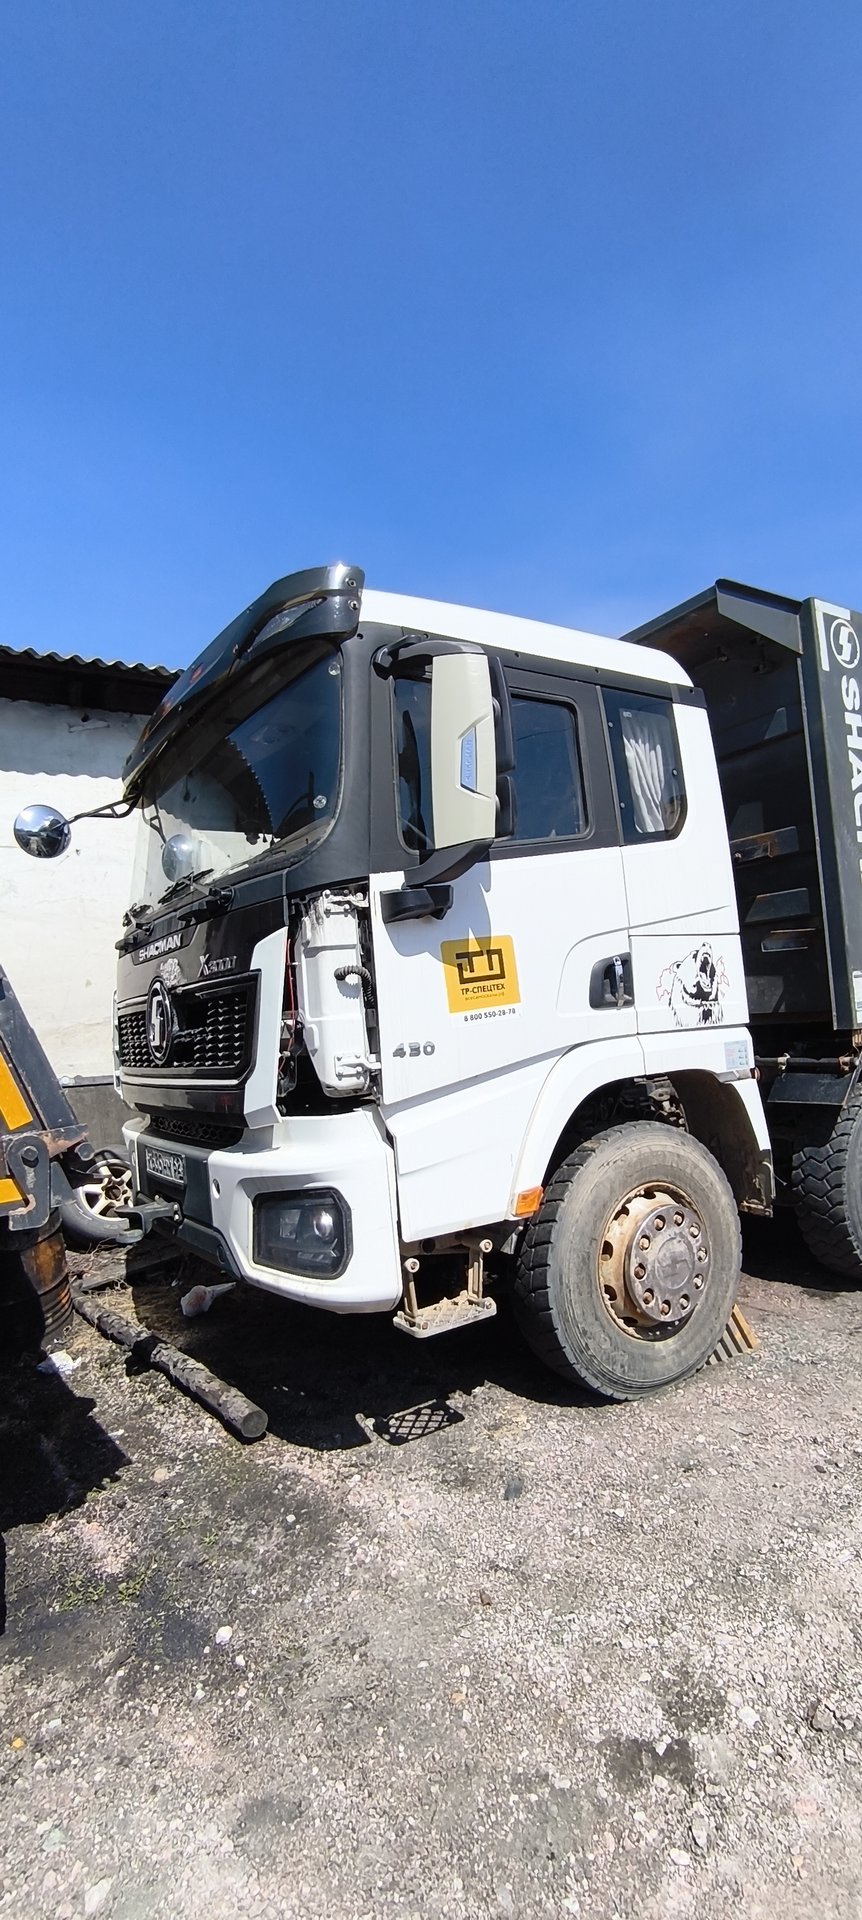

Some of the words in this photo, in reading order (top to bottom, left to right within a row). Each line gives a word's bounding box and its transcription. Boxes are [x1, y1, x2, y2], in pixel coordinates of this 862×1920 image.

[139, 934, 182, 961] SHACMAN
[461, 983, 506, 996] ТР-СПЕЦТЕХ
[470, 1012, 483, 1021] 800
[392, 1040, 436, 1058] 430
